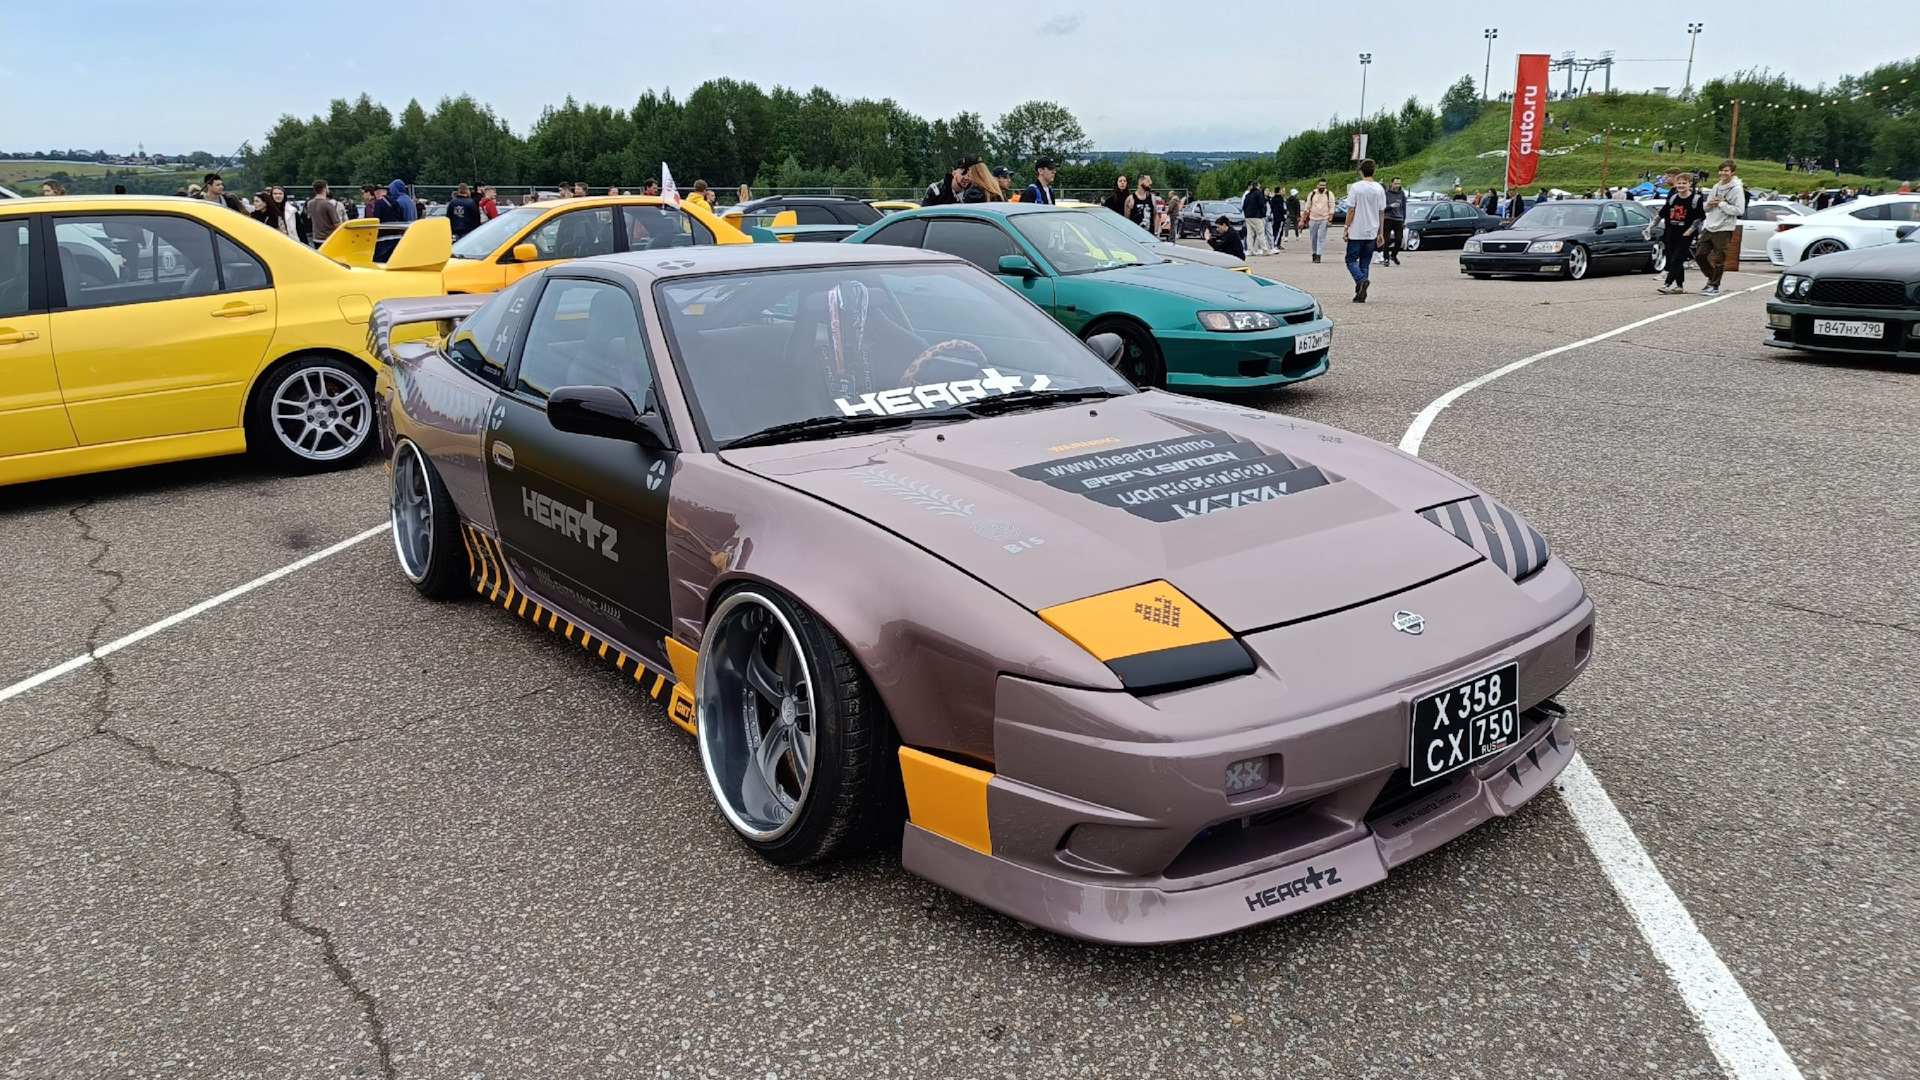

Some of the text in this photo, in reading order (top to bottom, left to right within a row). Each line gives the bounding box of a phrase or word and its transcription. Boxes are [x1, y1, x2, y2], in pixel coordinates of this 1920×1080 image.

[1520, 86, 1538, 155] auto.ru
[164, 256, 175, 269] 70
[1044, 438, 1215, 477] www.heartz.immo
[522, 486, 619, 563] HEARTZ
[1398, 615, 1421, 627] NISSAN
[1458, 674, 1501, 719] 358
[1476, 710, 1513, 745] 750
[1481, 741, 1497, 754] RUS
[1392, 792, 1461, 828] www.heartz.immo
[1245, 866, 1342, 912] HEARTZ
